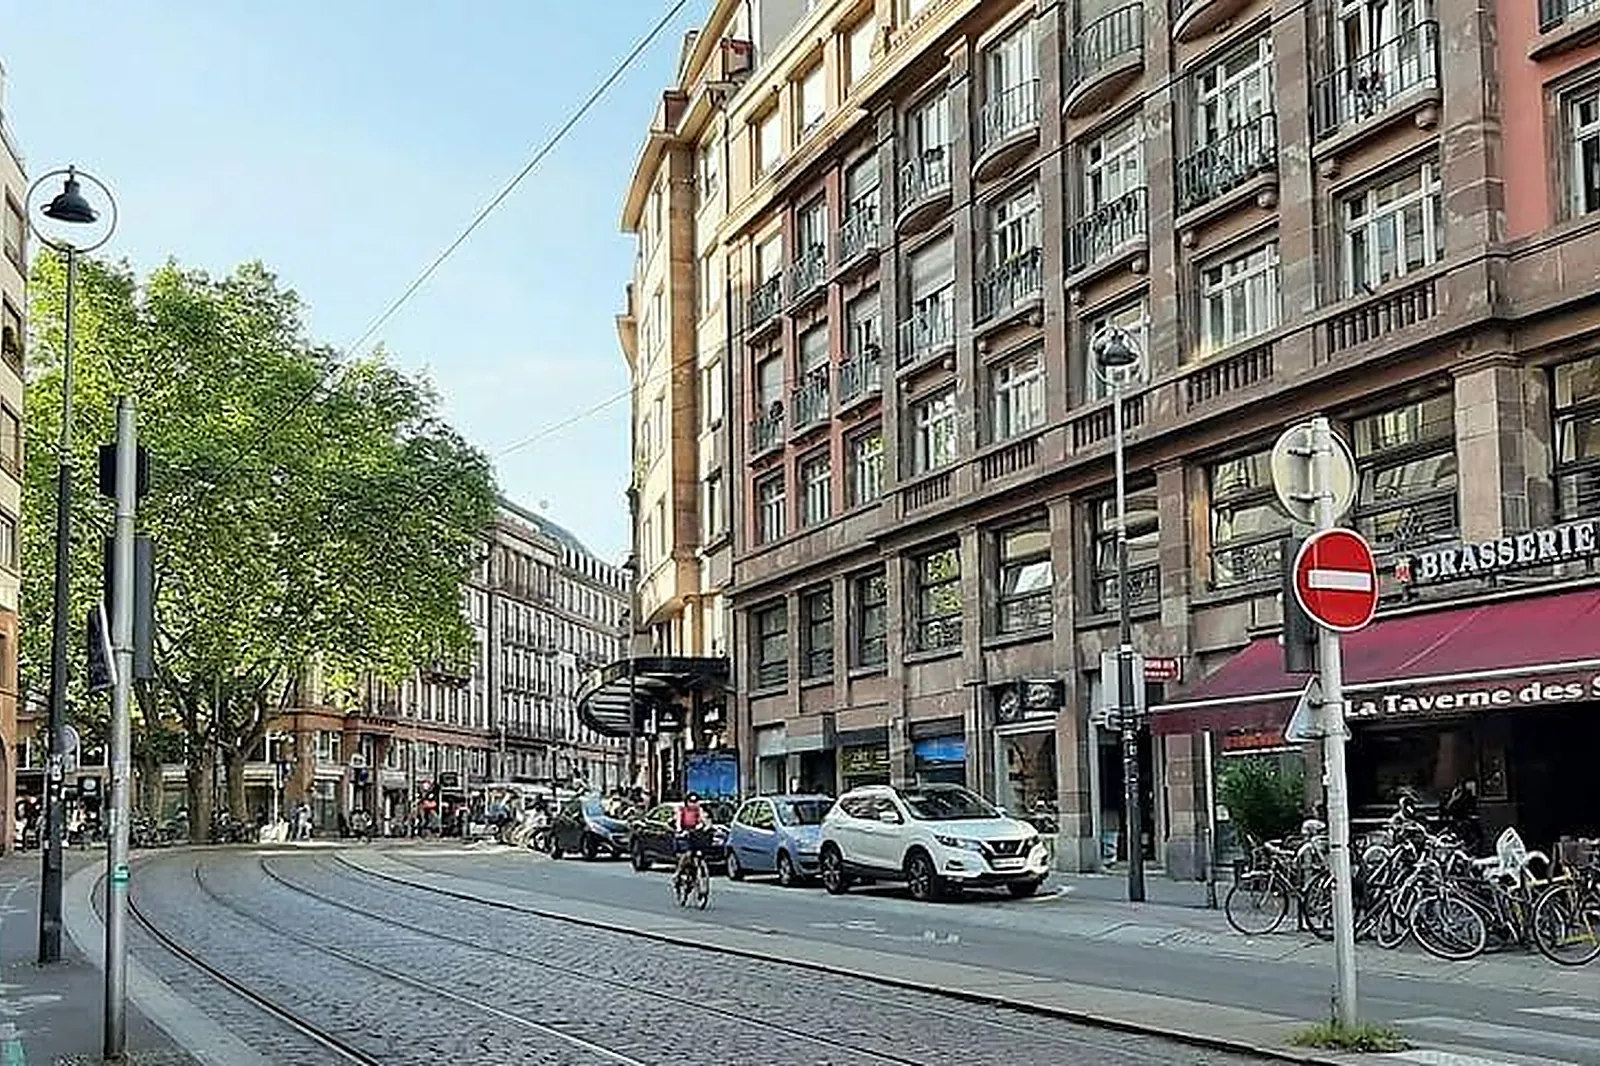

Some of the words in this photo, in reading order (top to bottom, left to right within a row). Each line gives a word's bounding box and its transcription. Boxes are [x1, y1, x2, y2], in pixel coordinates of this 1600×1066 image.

[1418, 523, 1595, 579] BRASSERIE
[1345, 700, 1378, 717] La
[1383, 689, 1511, 713] Taverne
[1519, 681, 1583, 702] des
